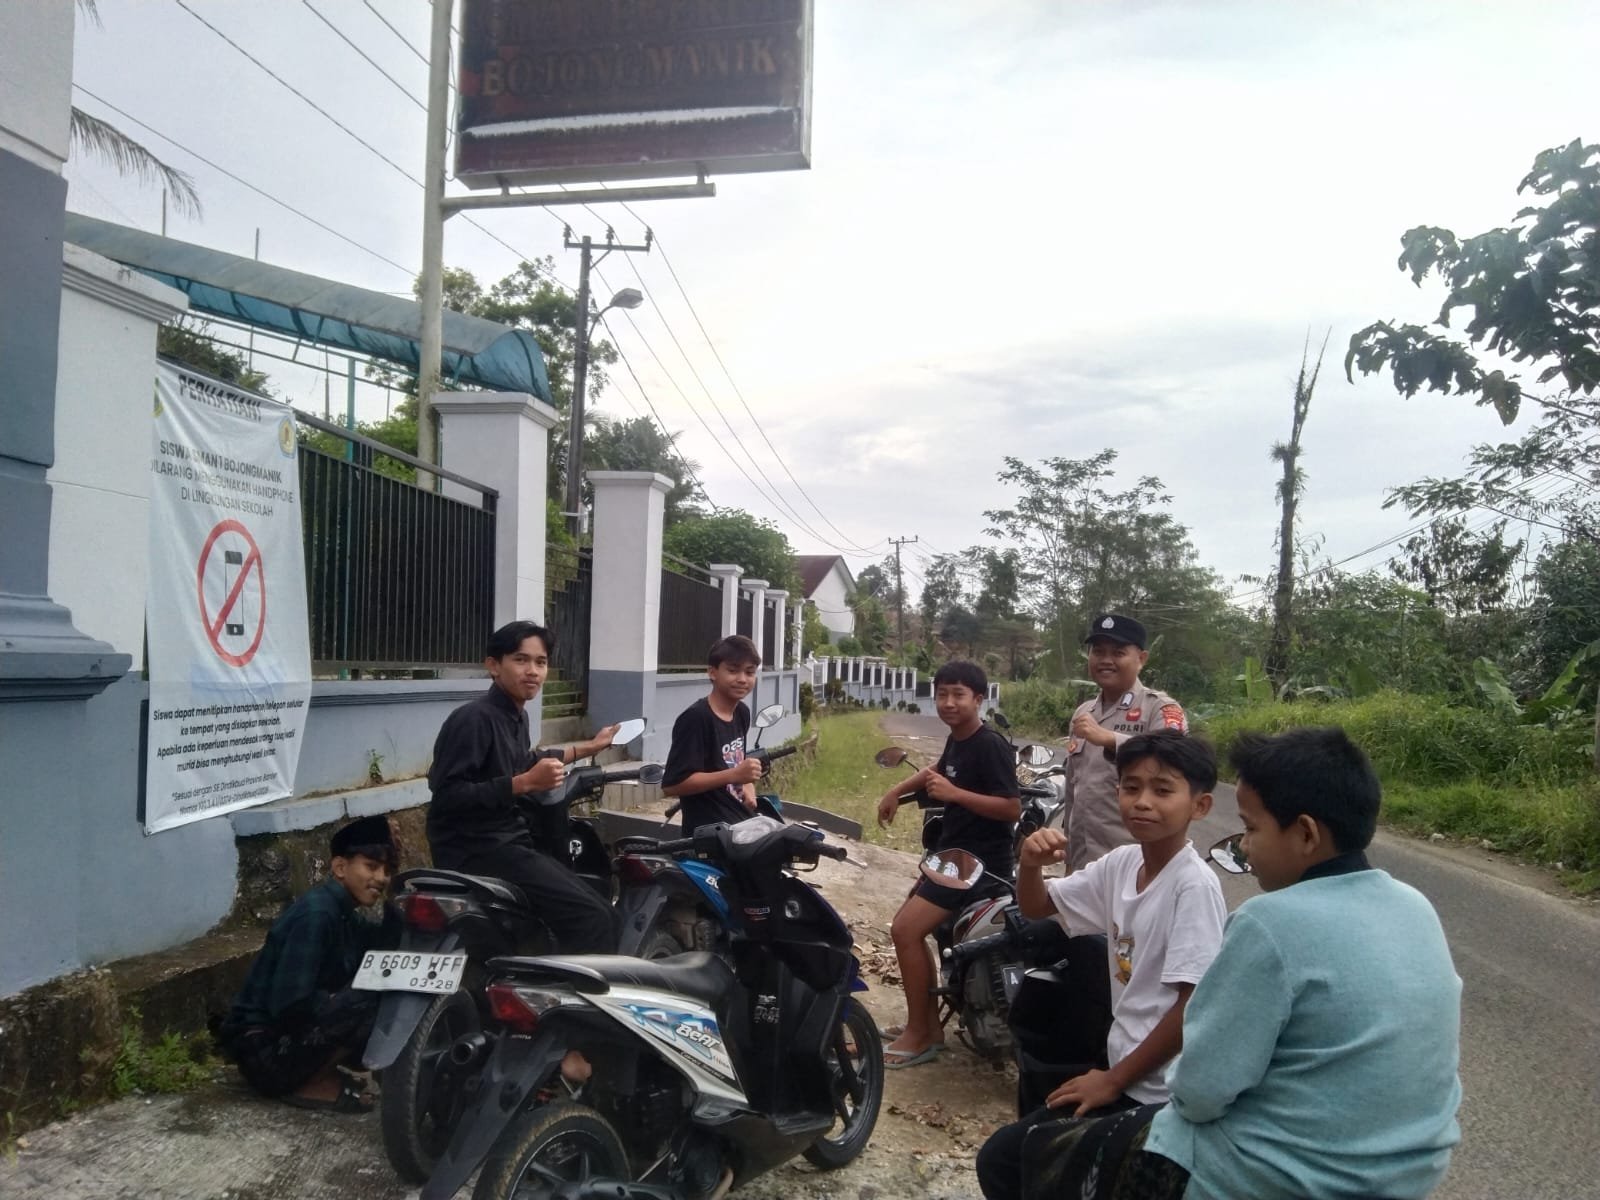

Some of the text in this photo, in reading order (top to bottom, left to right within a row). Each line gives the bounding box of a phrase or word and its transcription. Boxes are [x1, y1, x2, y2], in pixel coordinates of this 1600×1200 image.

[224, 458, 282, 484] BOJONGMANIK
[181, 486, 190, 500] DI
[241, 500, 274, 517] SEKOLAH
[153, 709, 173, 721] Siswa
[174, 708, 195, 721] dapat
[190, 722, 214, 737] tempat
[214, 722, 230, 735] yang
[1113, 724, 1144, 733] POLRI
[157, 744, 182, 760] Apabila
[182, 743, 196, 754] ada
[196, 757, 210, 769] bisa
[363, 954, 375, 969] B
[380, 954, 422, 970] 6609
